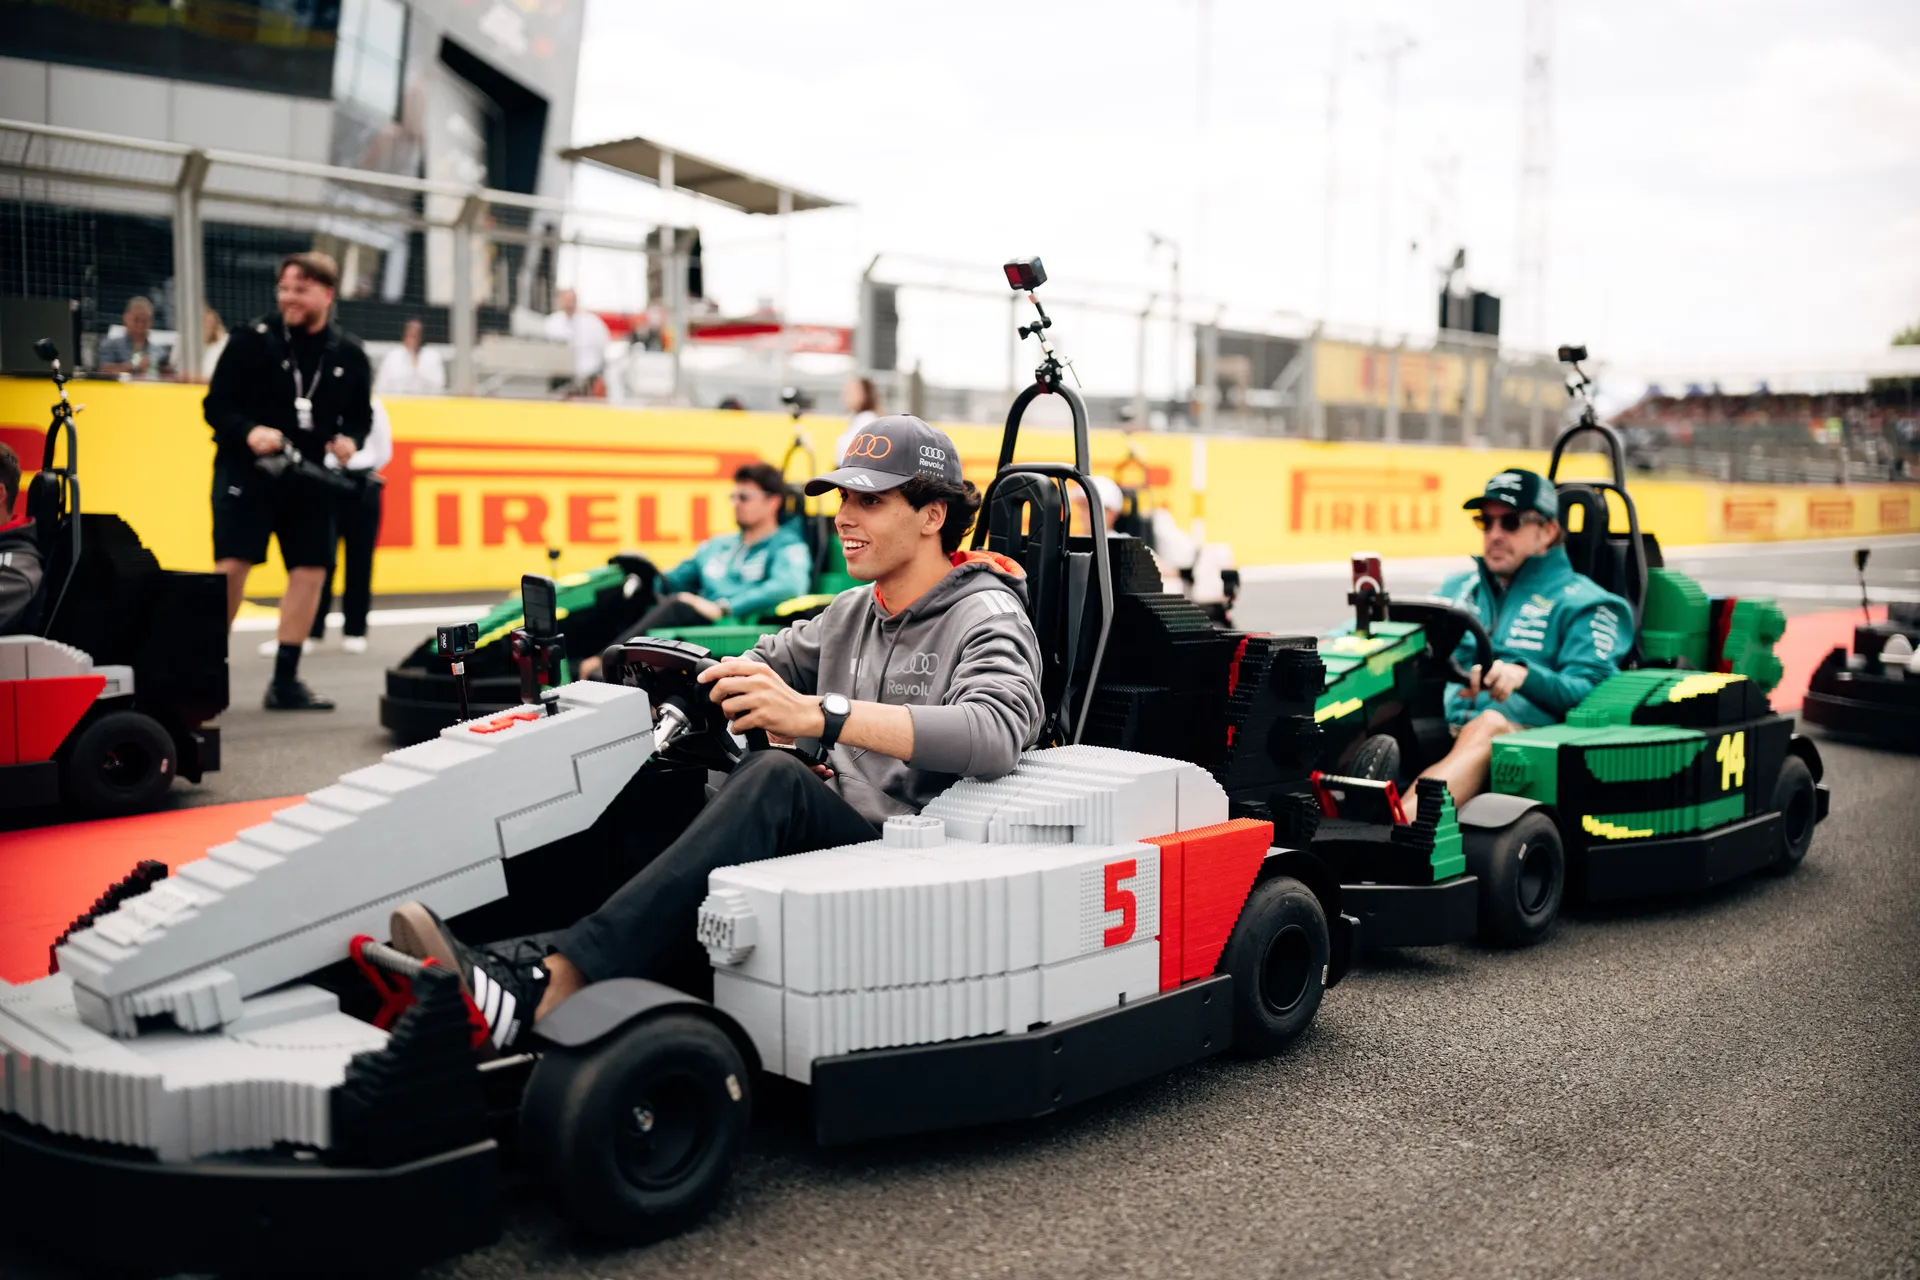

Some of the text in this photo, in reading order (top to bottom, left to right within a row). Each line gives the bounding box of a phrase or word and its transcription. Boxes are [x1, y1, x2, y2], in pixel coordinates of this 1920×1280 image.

[376, 441, 763, 547] PIRELL
[919, 458, 945, 471] Revolut
[886, 680, 931, 696] Revolu
[1715, 731, 1745, 791] 14
[1104, 858, 1137, 948] 5
